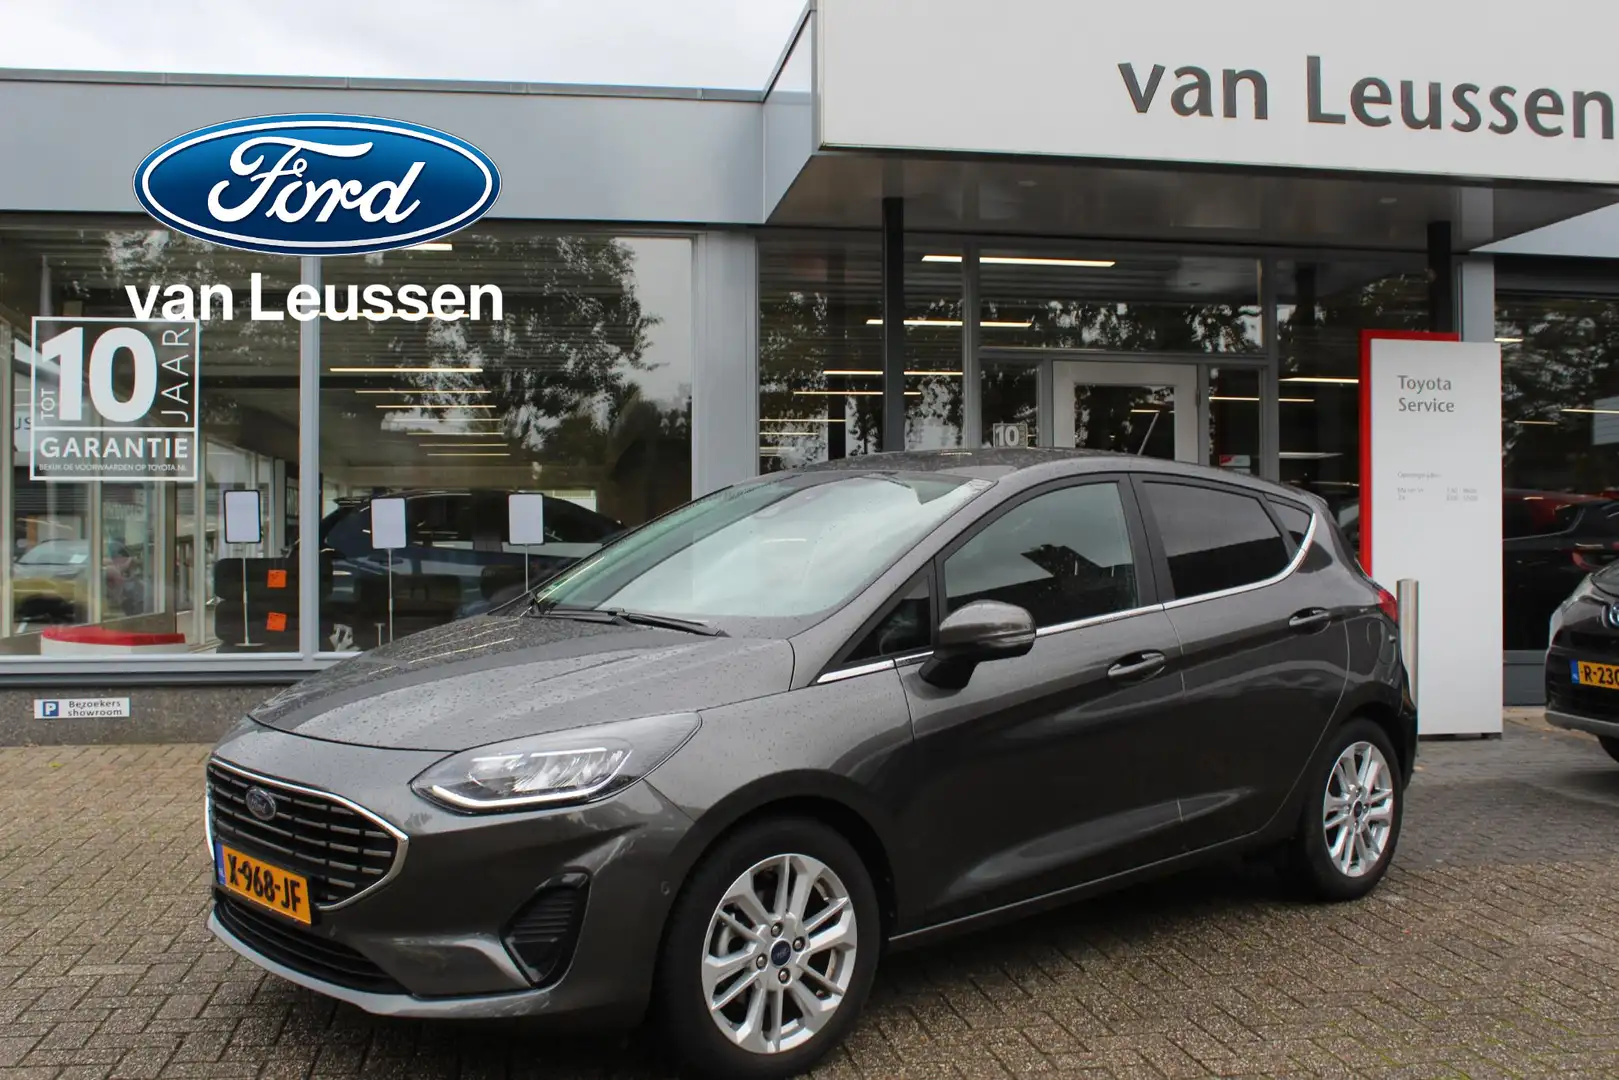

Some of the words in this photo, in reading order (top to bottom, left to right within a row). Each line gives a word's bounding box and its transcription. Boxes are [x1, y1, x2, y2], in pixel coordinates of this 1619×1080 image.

[1118, 63, 1268, 120] van
[1306, 55, 1614, 139] Leussen
[42, 327, 157, 422] 10
[161, 328, 190, 423] JAAR
[1397, 375, 1452, 394] Toyota
[41, 388, 56, 420] TOT
[1398, 397, 1455, 412] Service
[995, 425, 1019, 446] 10
[40, 437, 188, 458] GARANTIE
[64, 463, 74, 471] DE
[75, 463, 133, 471] VOORWAARDEN
[135, 463, 146, 471] OP
[68, 708, 122, 717] showroom
[69, 700, 121, 708] Bezoekers
[227, 852, 302, 912] X-968-JF
